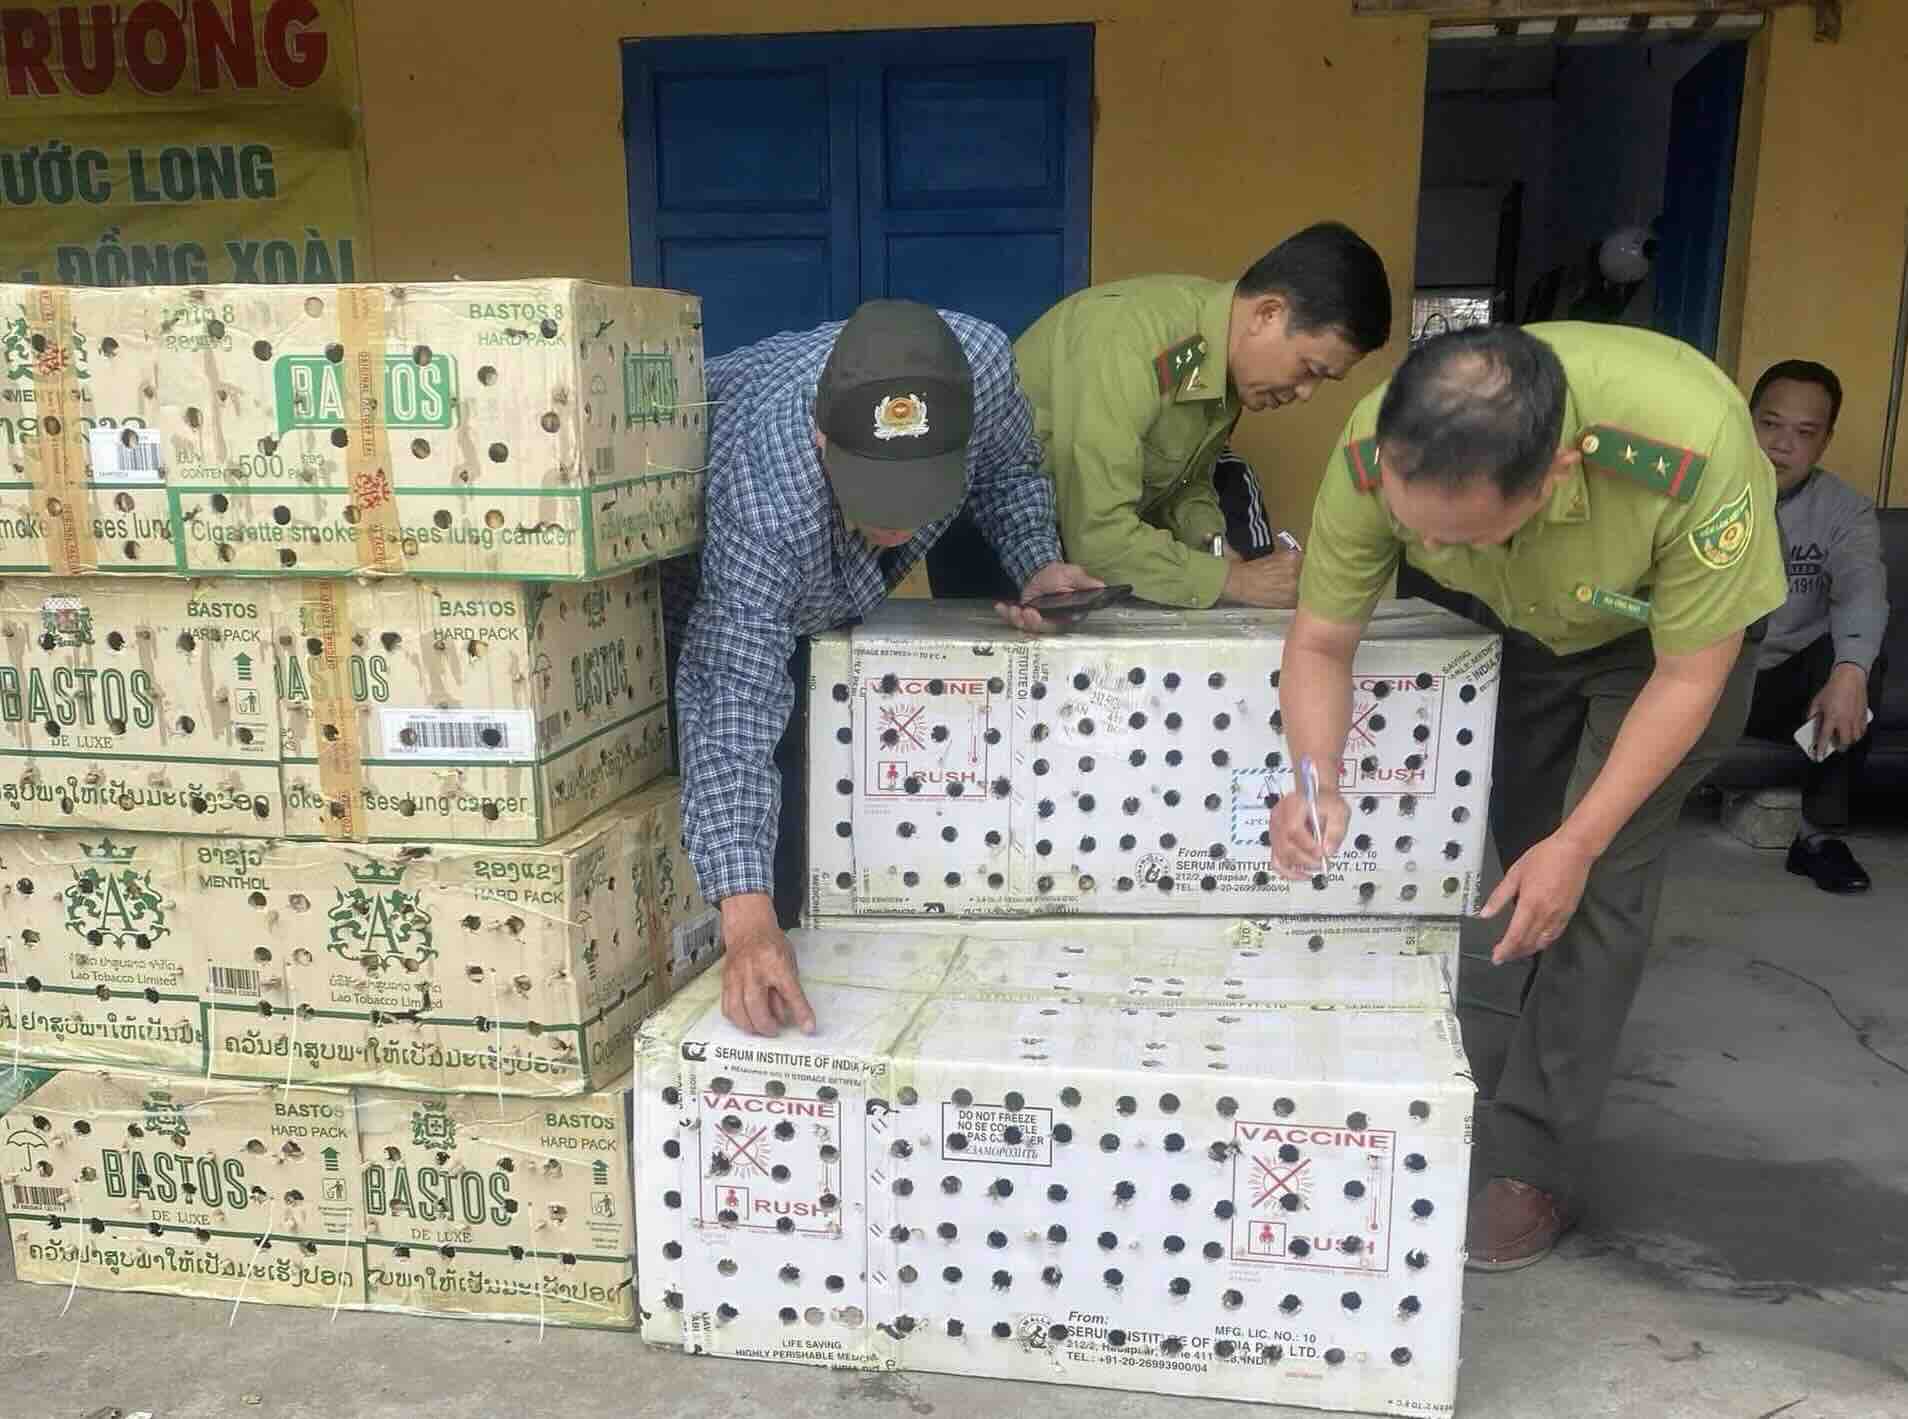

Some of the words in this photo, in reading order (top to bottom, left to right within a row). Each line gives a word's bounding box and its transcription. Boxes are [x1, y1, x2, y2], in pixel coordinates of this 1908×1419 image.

[129, 146, 277, 201] LONG
[470, 304, 547, 319] BASTOS
[553, 304, 563, 320] 8
[478, 334, 521, 347] HARD
[528, 333, 567, 346] PACK
[239, 455, 284, 479] 500
[191, 520, 287, 546] Cigarette
[449, 524, 494, 551] lung
[187, 602, 258, 619] BASTOS
[440, 601, 516, 617] BASTOS
[224, 629, 260, 642] PACK
[433, 627, 475, 641] HARD
[479, 628, 519, 642] PACK
[0, 666, 155, 729] BASTOS
[51, 734, 71, 747] DE
[77, 735, 113, 749] LUXE
[912, 770, 976, 784] RUSH
[456, 796, 527, 813] cancer
[1177, 847, 1208, 858] From:
[1175, 860, 1215, 871] SERUM
[1218, 861, 1273, 872] INSTITUTE
[199, 873, 270, 890] MENTHOL
[523, 889, 565, 904] PACK
[71, 969, 90, 981] Lao
[93, 971, 135, 983] Tobacco
[137, 973, 177, 986] Limited
[331, 991, 351, 1003] Lao
[354, 993, 399, 1006] Tobacco
[714, 1046, 754, 1062] SERUM
[756, 1050, 812, 1068] INSTITUTE
[814, 1056, 831, 1069] OF
[832, 1058, 860, 1073] INDIA
[275, 1103, 345, 1118] BASTOS
[704, 1095, 835, 1119] VACCINE
[546, 1113, 615, 1130] BASTOS
[959, 1110, 973, 1120] DO
[975, 1111, 997, 1121] NOT
[999, 1112, 1038, 1124] FREEZE
[271, 1125, 307, 1138] HARD
[311, 1127, 348, 1139] PACK
[958, 1121, 973, 1131] NO
[974, 1122, 988, 1132] SE
[541, 1135, 577, 1150] HARD
[580, 1137, 617, 1151] PACK
[1239, 1126, 1391, 1149] VACCINE
[101, 1148, 248, 1209] BASTOS
[365, 1163, 512, 1225] BASTOS
[152, 1209, 171, 1222] DE
[176, 1211, 210, 1225] LUXE
[410, 1227, 431, 1241] DE
[437, 1230, 473, 1244] LUXE
[1068, 1311, 1108, 1326] From:
[1191, 1336, 1210, 1349] OF
[1215, 1325, 1243, 1338] MFG.
[1303, 1334, 1317, 1344] 10
[783, 1339, 803, 1349] LIFE
[805, 1340, 842, 1351] SAVING
[736, 1349, 770, 1359] HIGHLY
[772, 1350, 834, 1361] PERISHABLE
